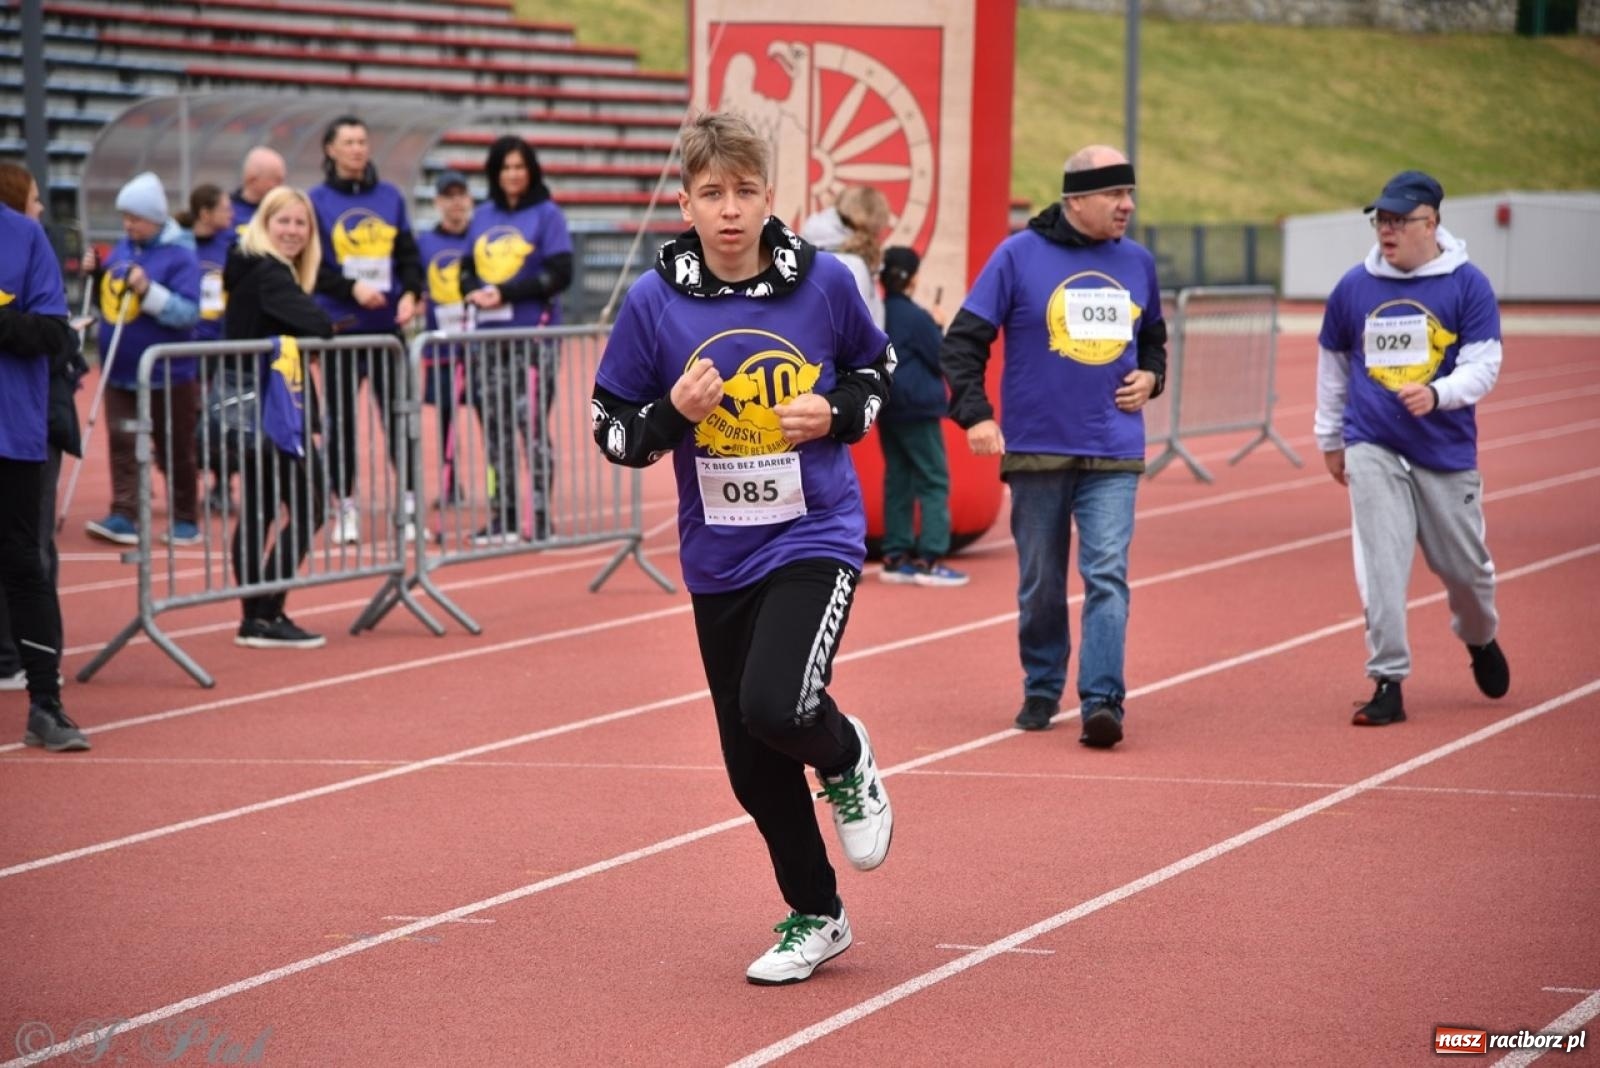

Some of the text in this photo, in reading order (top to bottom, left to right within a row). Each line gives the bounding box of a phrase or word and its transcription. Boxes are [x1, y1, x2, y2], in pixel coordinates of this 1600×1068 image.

[1082, 306, 1118, 322] 033
[1376, 334, 1412, 350] 029
[750, 363, 798, 409] 10
[713, 462, 735, 470] BIEG
[737, 461, 756, 470] BEZ
[722, 479, 779, 504] 085
